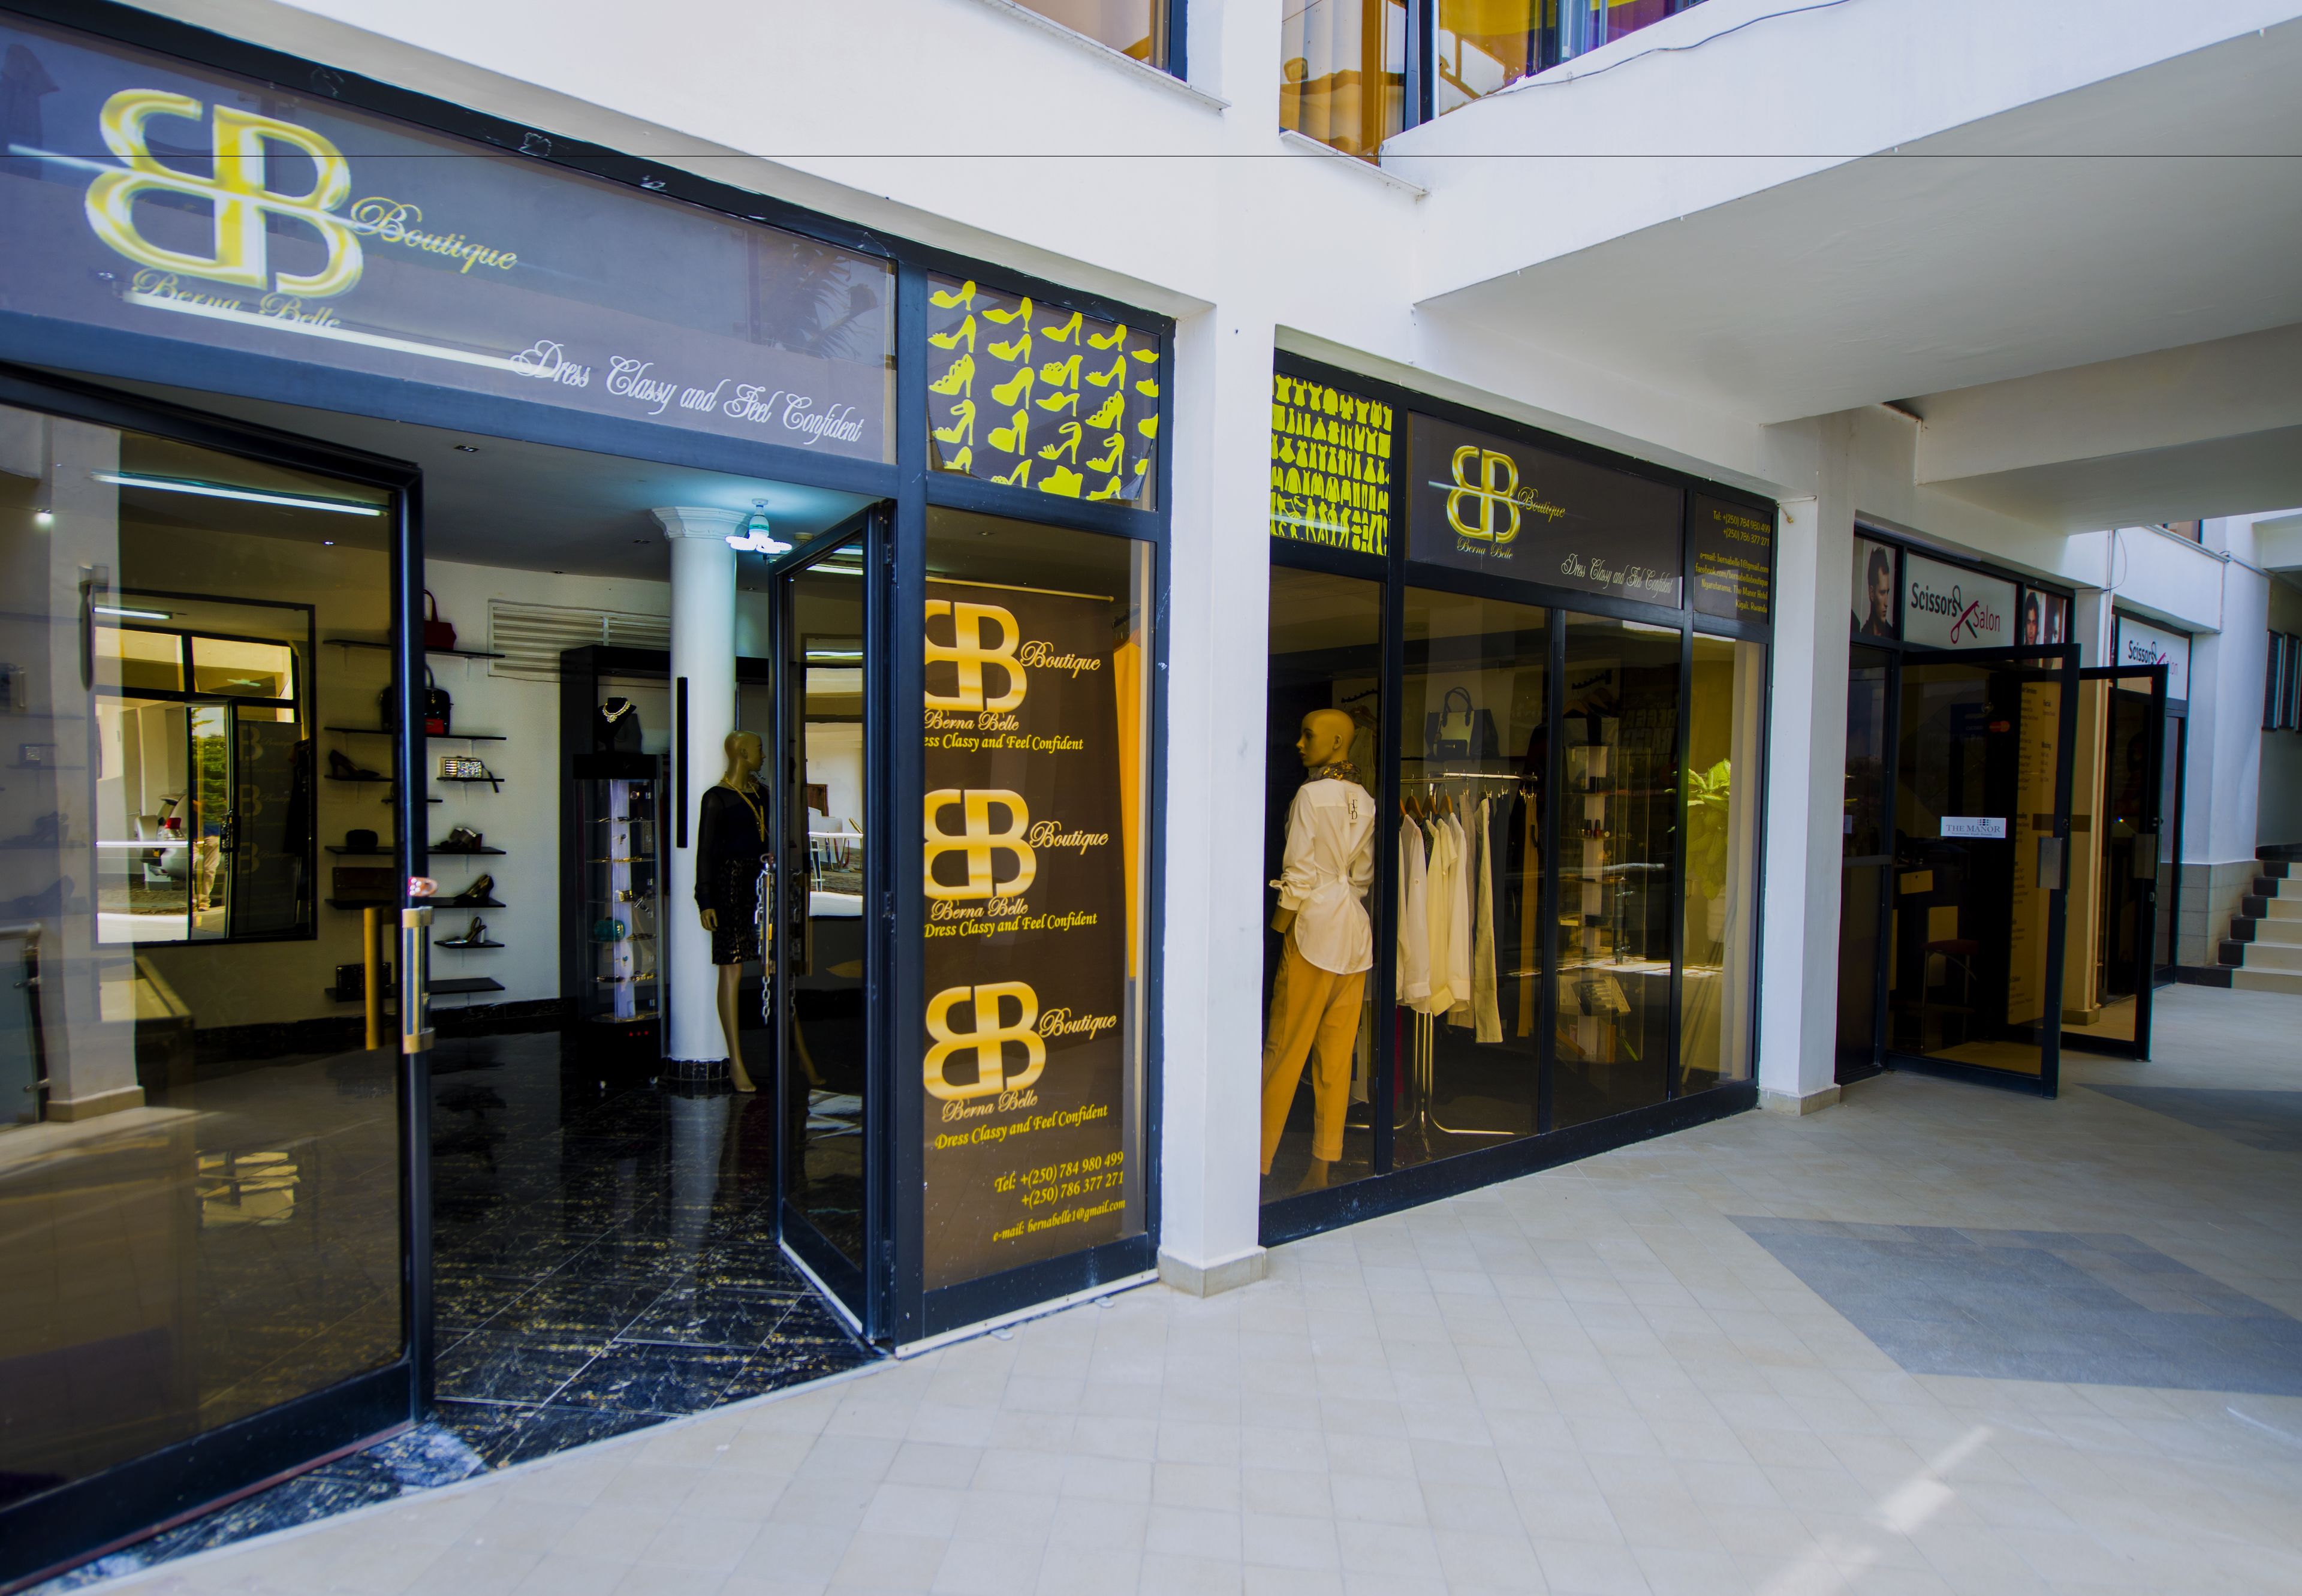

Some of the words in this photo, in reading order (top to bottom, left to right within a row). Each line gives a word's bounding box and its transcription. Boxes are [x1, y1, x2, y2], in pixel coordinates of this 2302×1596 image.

[349, 197, 518, 274] Boutique
[131, 268, 242, 312] Berna
[259, 292, 341, 330] Belle
[510, 340, 590, 387] Dress
[606, 356, 677, 415] Classy
[680, 379, 730, 412] and
[723, 384, 784, 423] Feel
[782, 393, 865, 445] Confident
[1517, 486, 1566, 523] Boutique
[1713, 510, 1722, 521] Tel:
[1723, 514, 1740, 528] +(250)
[1740, 517, 1750, 528] 784
[1750, 520, 1761, 531] 980
[1761, 522, 1771, 534] 499
[1723, 528, 1740, 541] +(250)
[1740, 531, 1750, 542] 786
[1750, 534, 1760, 545] 377
[1761, 537, 1770, 547] 271
[1457, 535, 1487, 555] Berna
[1490, 541, 1514, 561] Belle
[1700, 552, 1716, 562] e-mail:
[1717, 553, 1768, 573] bernabelle1@gmail.com
[1561, 553, 1586, 578] Dress
[1590, 558, 1613, 589] Classy
[1613, 564, 1629, 585] and
[1626, 566, 1646, 589] Feel
[1644, 569, 1673, 598] Confident
[1695, 562, 1768, 586] facebook.com/bernabelleboutique
[1742, 587, 1756, 598] Manor
[1757, 590, 1768, 600] Hotel
[1750, 602, 1768, 613] Rwanda
[1911, 582, 1958, 618] Scissors
[1973, 603, 2001, 633] Salon
[1020, 640, 1101, 678] Boutique
[2128, 640, 2154, 665] Scissors
[925, 709, 975, 730] Berna
[978, 709, 1019, 731] Belle
[924, 737, 940, 748] ess
[942, 733, 979, 752] Classy
[982, 734, 1004, 748] and
[1007, 734, 1030, 749] Feel
[1031, 735, 1084, 754] Confident
[1029, 821, 1109, 855] Boutique
[924, 923, 956, 938] Dress
[959, 919, 995, 938] Classy
[998, 916, 1019, 932] and
[1022, 913, 1047, 931] Feel
[1047, 911, 1098, 932] Confident
[931, 897, 984, 921] Berna
[988, 895, 1029, 917] Belle
[1039, 1007, 1117, 1040] Boutique
[942, 1098, 995, 1123] Berna
[998, 1088, 1038, 1112] Belle
[935, 1133, 969, 1151] Dress
[971, 1124, 1007, 1143] Classy
[1010, 1116, 1031, 1135] and
[1033, 1111, 1056, 1130] Feel
[1057, 1103, 1108, 1127] Confident
[994, 1173, 1016, 1193] Tel:
[1020, 1164, 1057, 1190] +(250)
[1060, 1162, 1079, 1179] 784
[1082, 1156, 1102, 1174] 980
[1104, 1151, 1124, 1168] 499
[1022, 1184, 1058, 1210] +(250)
[1060, 1181, 1080, 1199] 786
[1083, 1175, 1102, 1193] 377
[1105, 1170, 1124, 1188] 271
[992, 1221, 1025, 1242] e-mail:
[1027, 1198, 1126, 1233] bernabelle1@gmail.com
